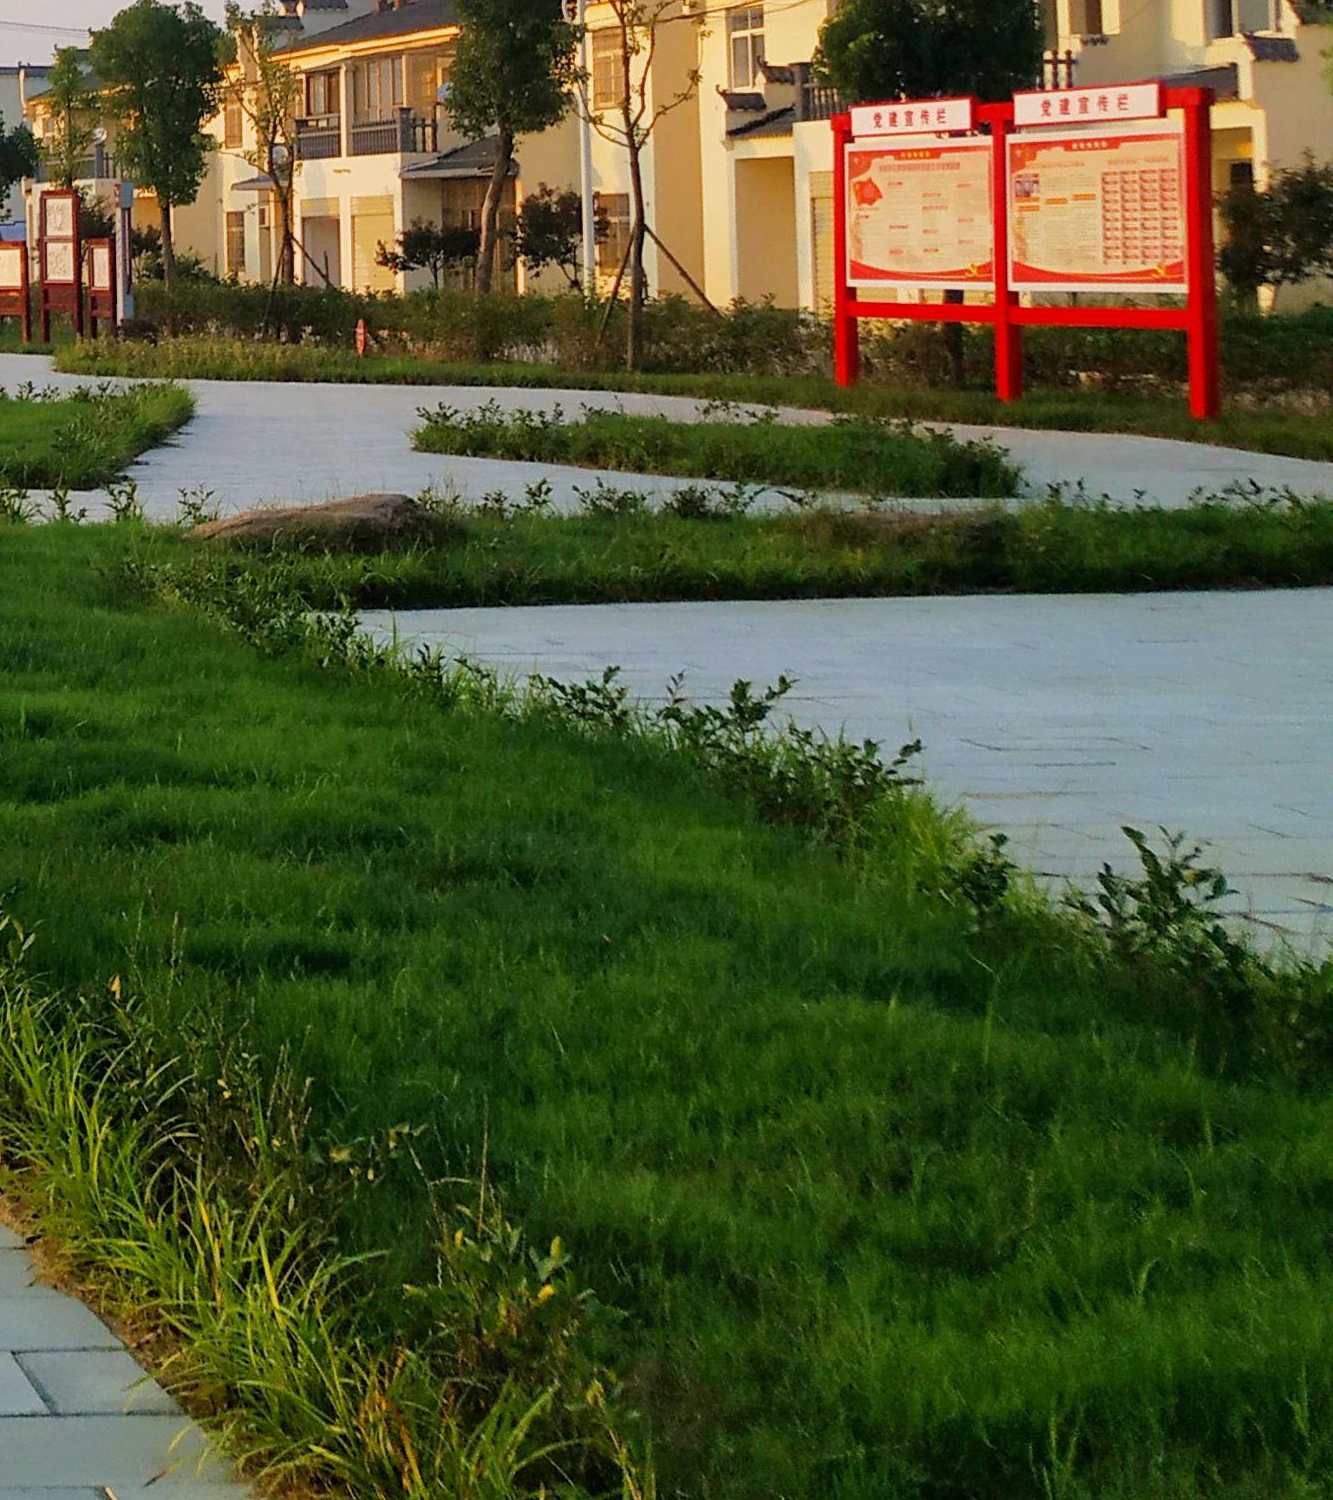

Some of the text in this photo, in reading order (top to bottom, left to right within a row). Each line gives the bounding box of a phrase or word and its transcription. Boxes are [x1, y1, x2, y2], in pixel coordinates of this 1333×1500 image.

[1041, 93, 1129, 117] 党建宣传栏
[873, 108, 946, 129] 党建宣传栏
